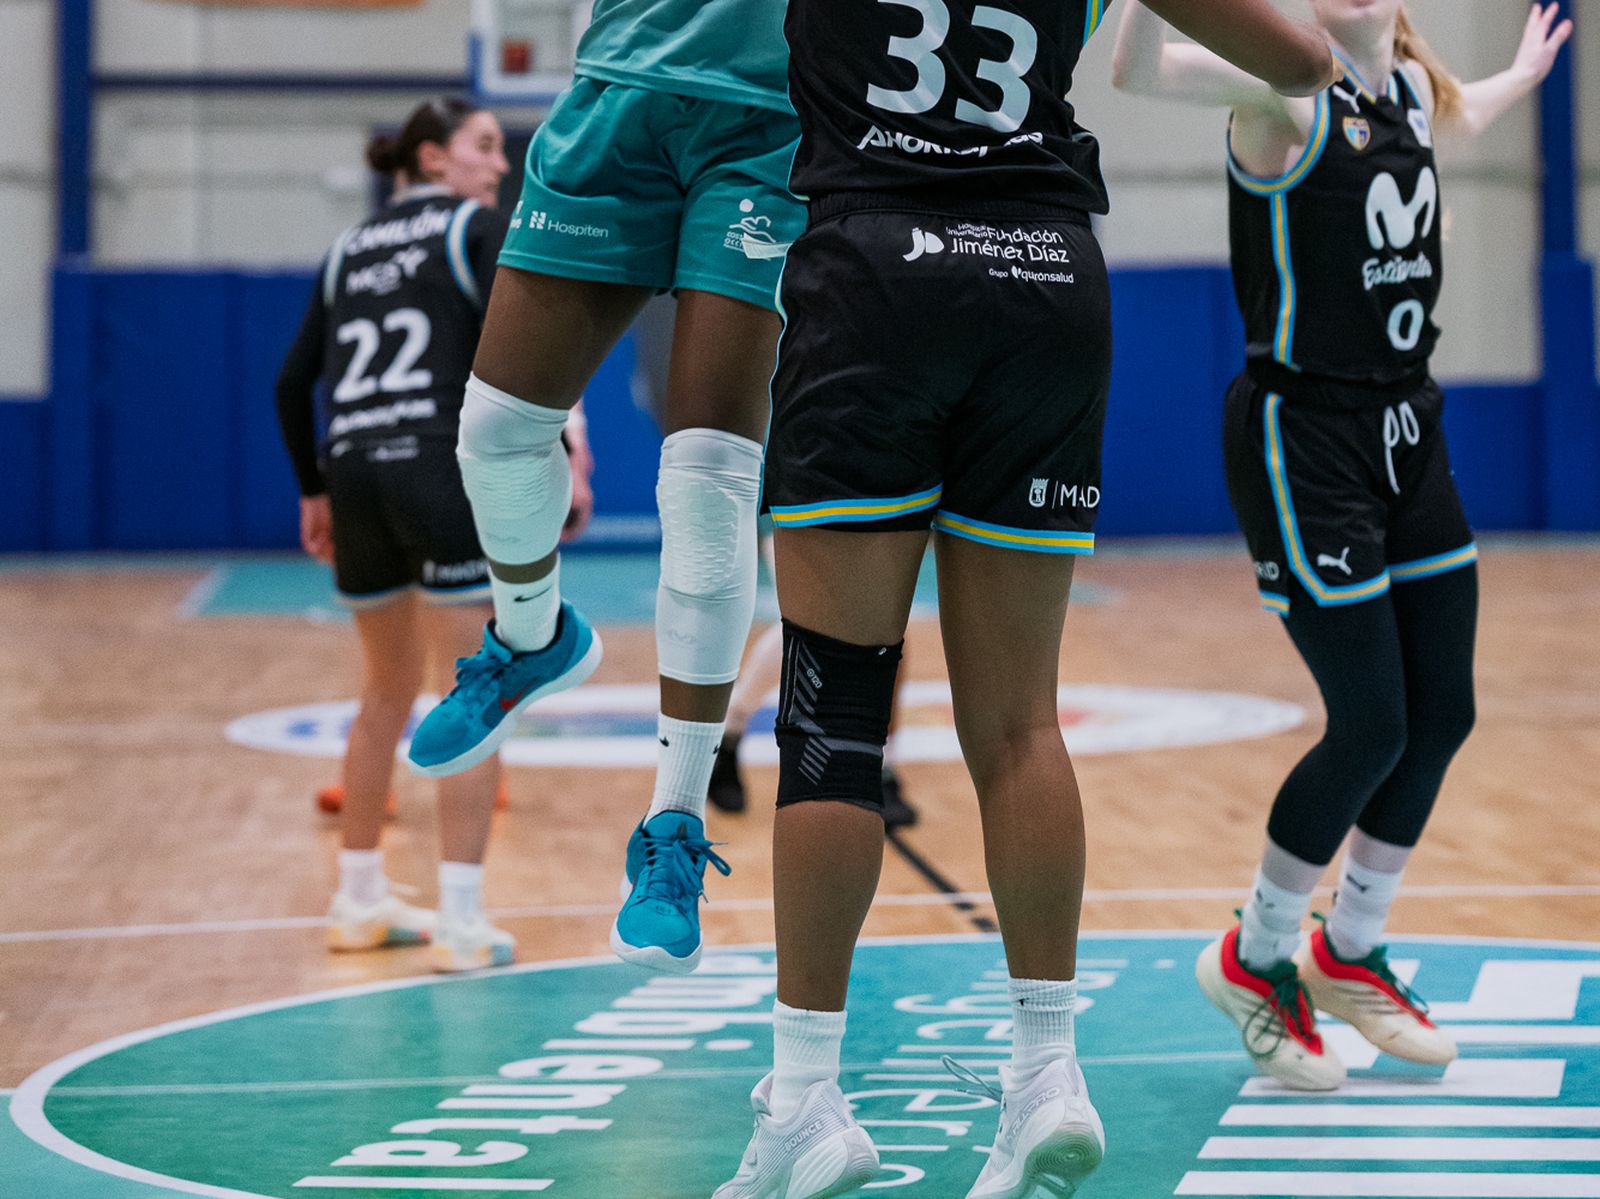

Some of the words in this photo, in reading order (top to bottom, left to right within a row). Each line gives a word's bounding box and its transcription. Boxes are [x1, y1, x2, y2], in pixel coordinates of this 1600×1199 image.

[547, 220, 609, 238] Hospiten
[986, 227, 1064, 244] Fundación
[951, 238, 1025, 262] Jiménez
[1029, 244, 1070, 263] Díaz
[1387, 299, 1424, 350] 0
[333, 307, 432, 404] 22
[1060, 483, 1100, 508] MAD
